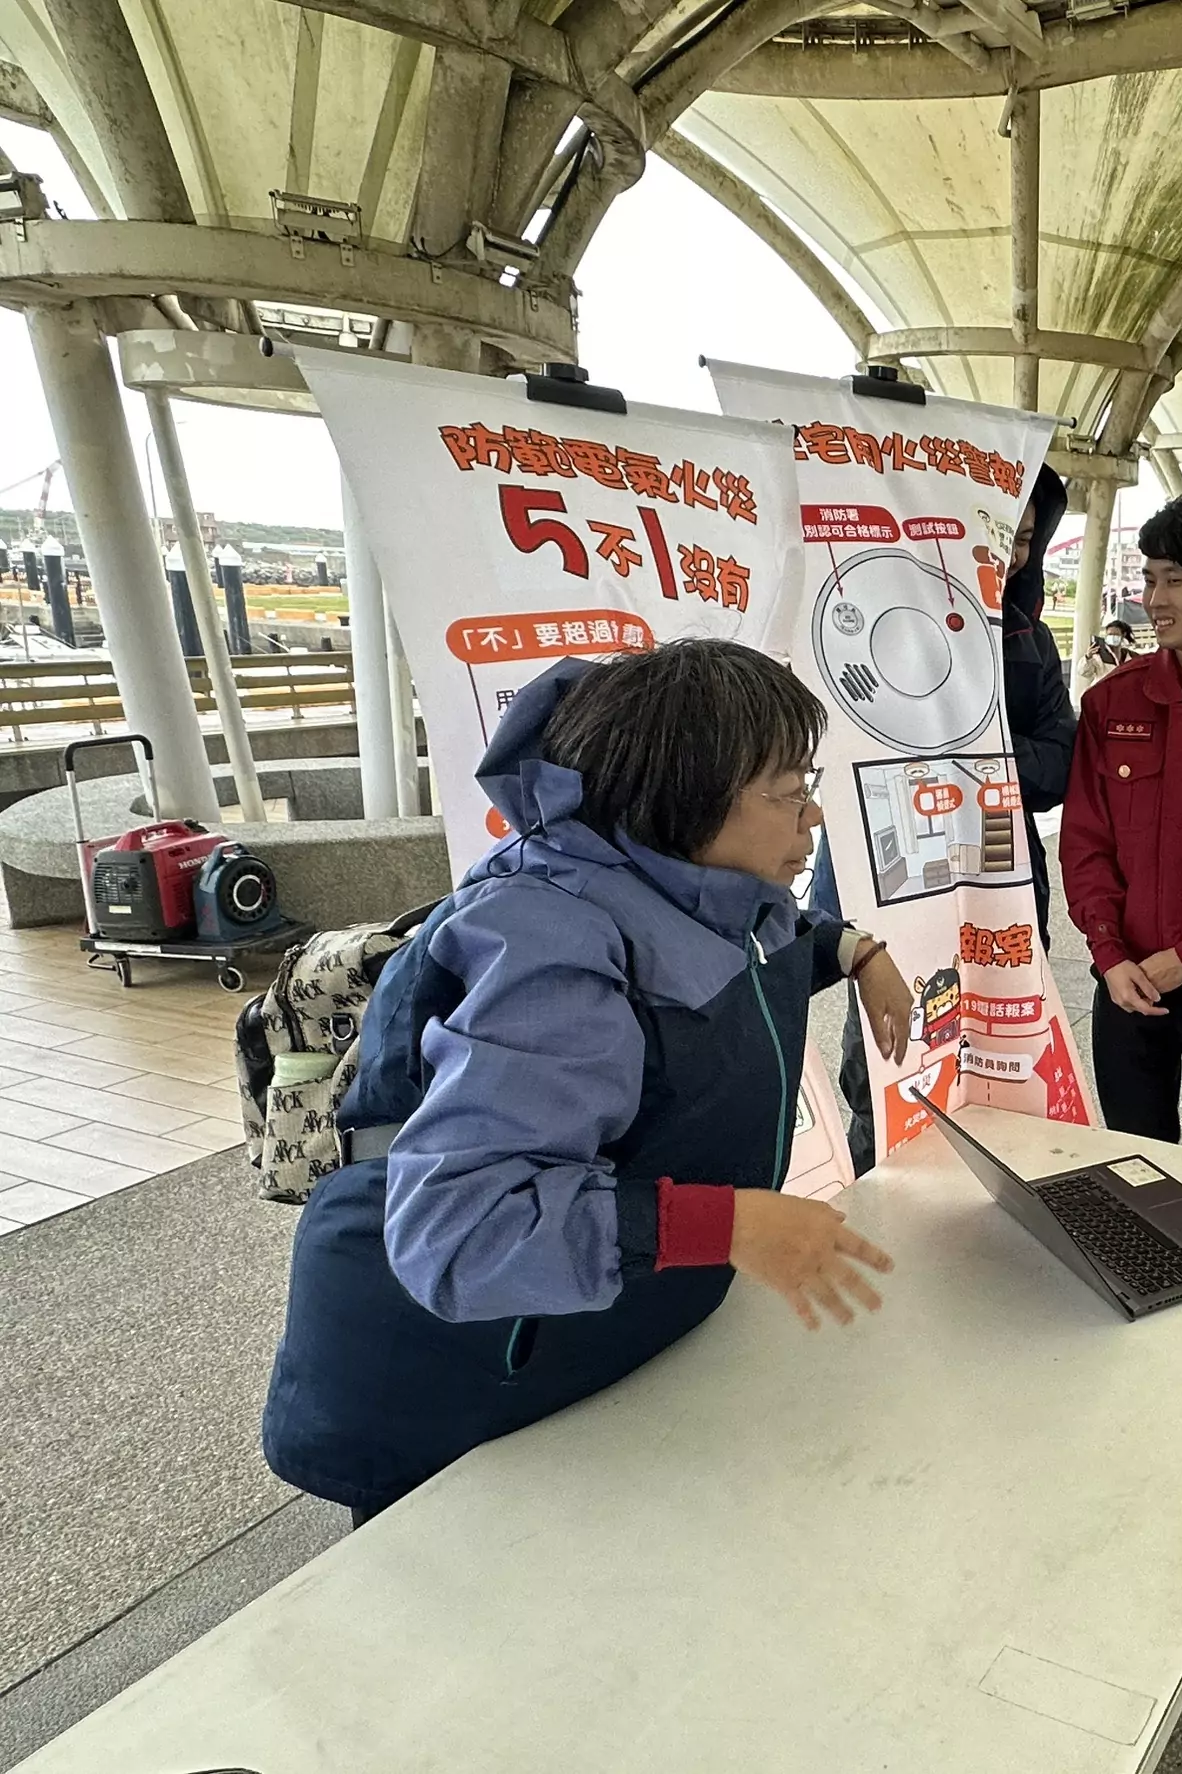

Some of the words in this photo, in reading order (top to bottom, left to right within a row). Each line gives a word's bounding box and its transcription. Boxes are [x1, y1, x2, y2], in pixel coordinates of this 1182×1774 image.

[438, 422, 757, 525] 防範電氣火災
[819, 507, 860, 522] 消防署
[802, 524, 894, 539] 別認可合格標示
[909, 522, 960, 536] 測試按鈕
